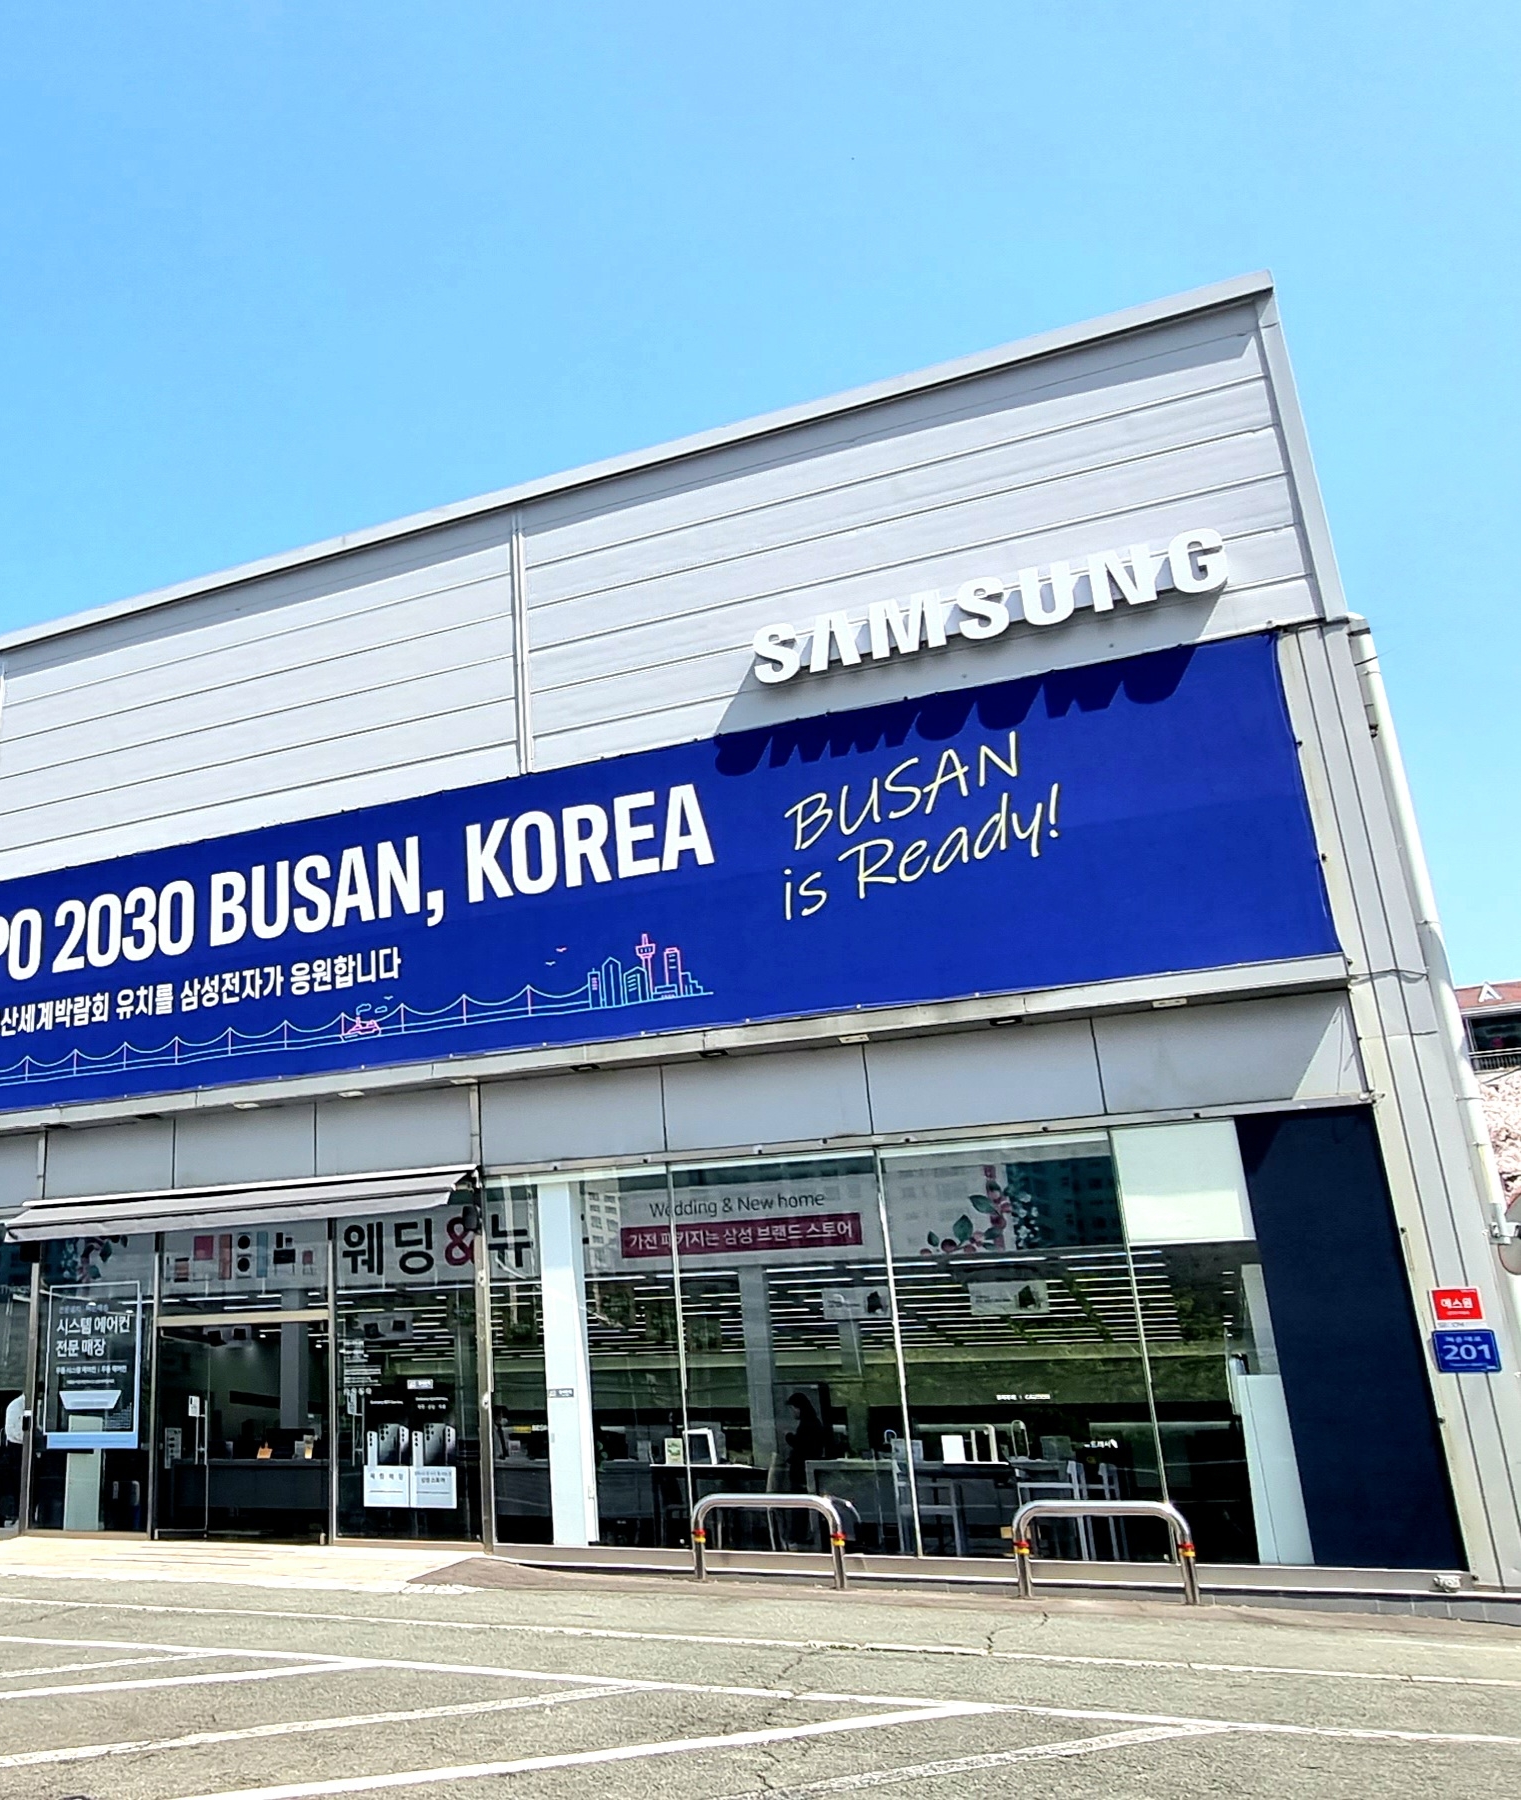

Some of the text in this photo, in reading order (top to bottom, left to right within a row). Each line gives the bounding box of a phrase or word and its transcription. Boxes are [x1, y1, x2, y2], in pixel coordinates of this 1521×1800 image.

[751, 526, 1228, 685] SAMSUNG
[784, 730, 1021, 852] BUSAN
[783, 782, 1060, 920] is Ready!
[52, 881, 195, 973] 2030
[210, 836, 445, 947] BUSAN,
[465, 784, 715, 904] KOREA
[116, 984, 174, 1019] 유치를
[180, 973, 285, 1011] 삼성전자가
[290, 947, 402, 996] 응원합니다
[649, 1193, 825, 1219] Wedding & New home
[629, 1231, 658, 1250] 가전
[723, 1228, 753, 1246] 삼성
[757, 1223, 803, 1243] 브랜드
[805, 1220, 853, 1239] 스토어
[55, 1338, 106, 1358] 전문 매장
[56, 1315, 130, 1337] 시스템 에어컨
[1442, 1344, 1491, 1360] 201
